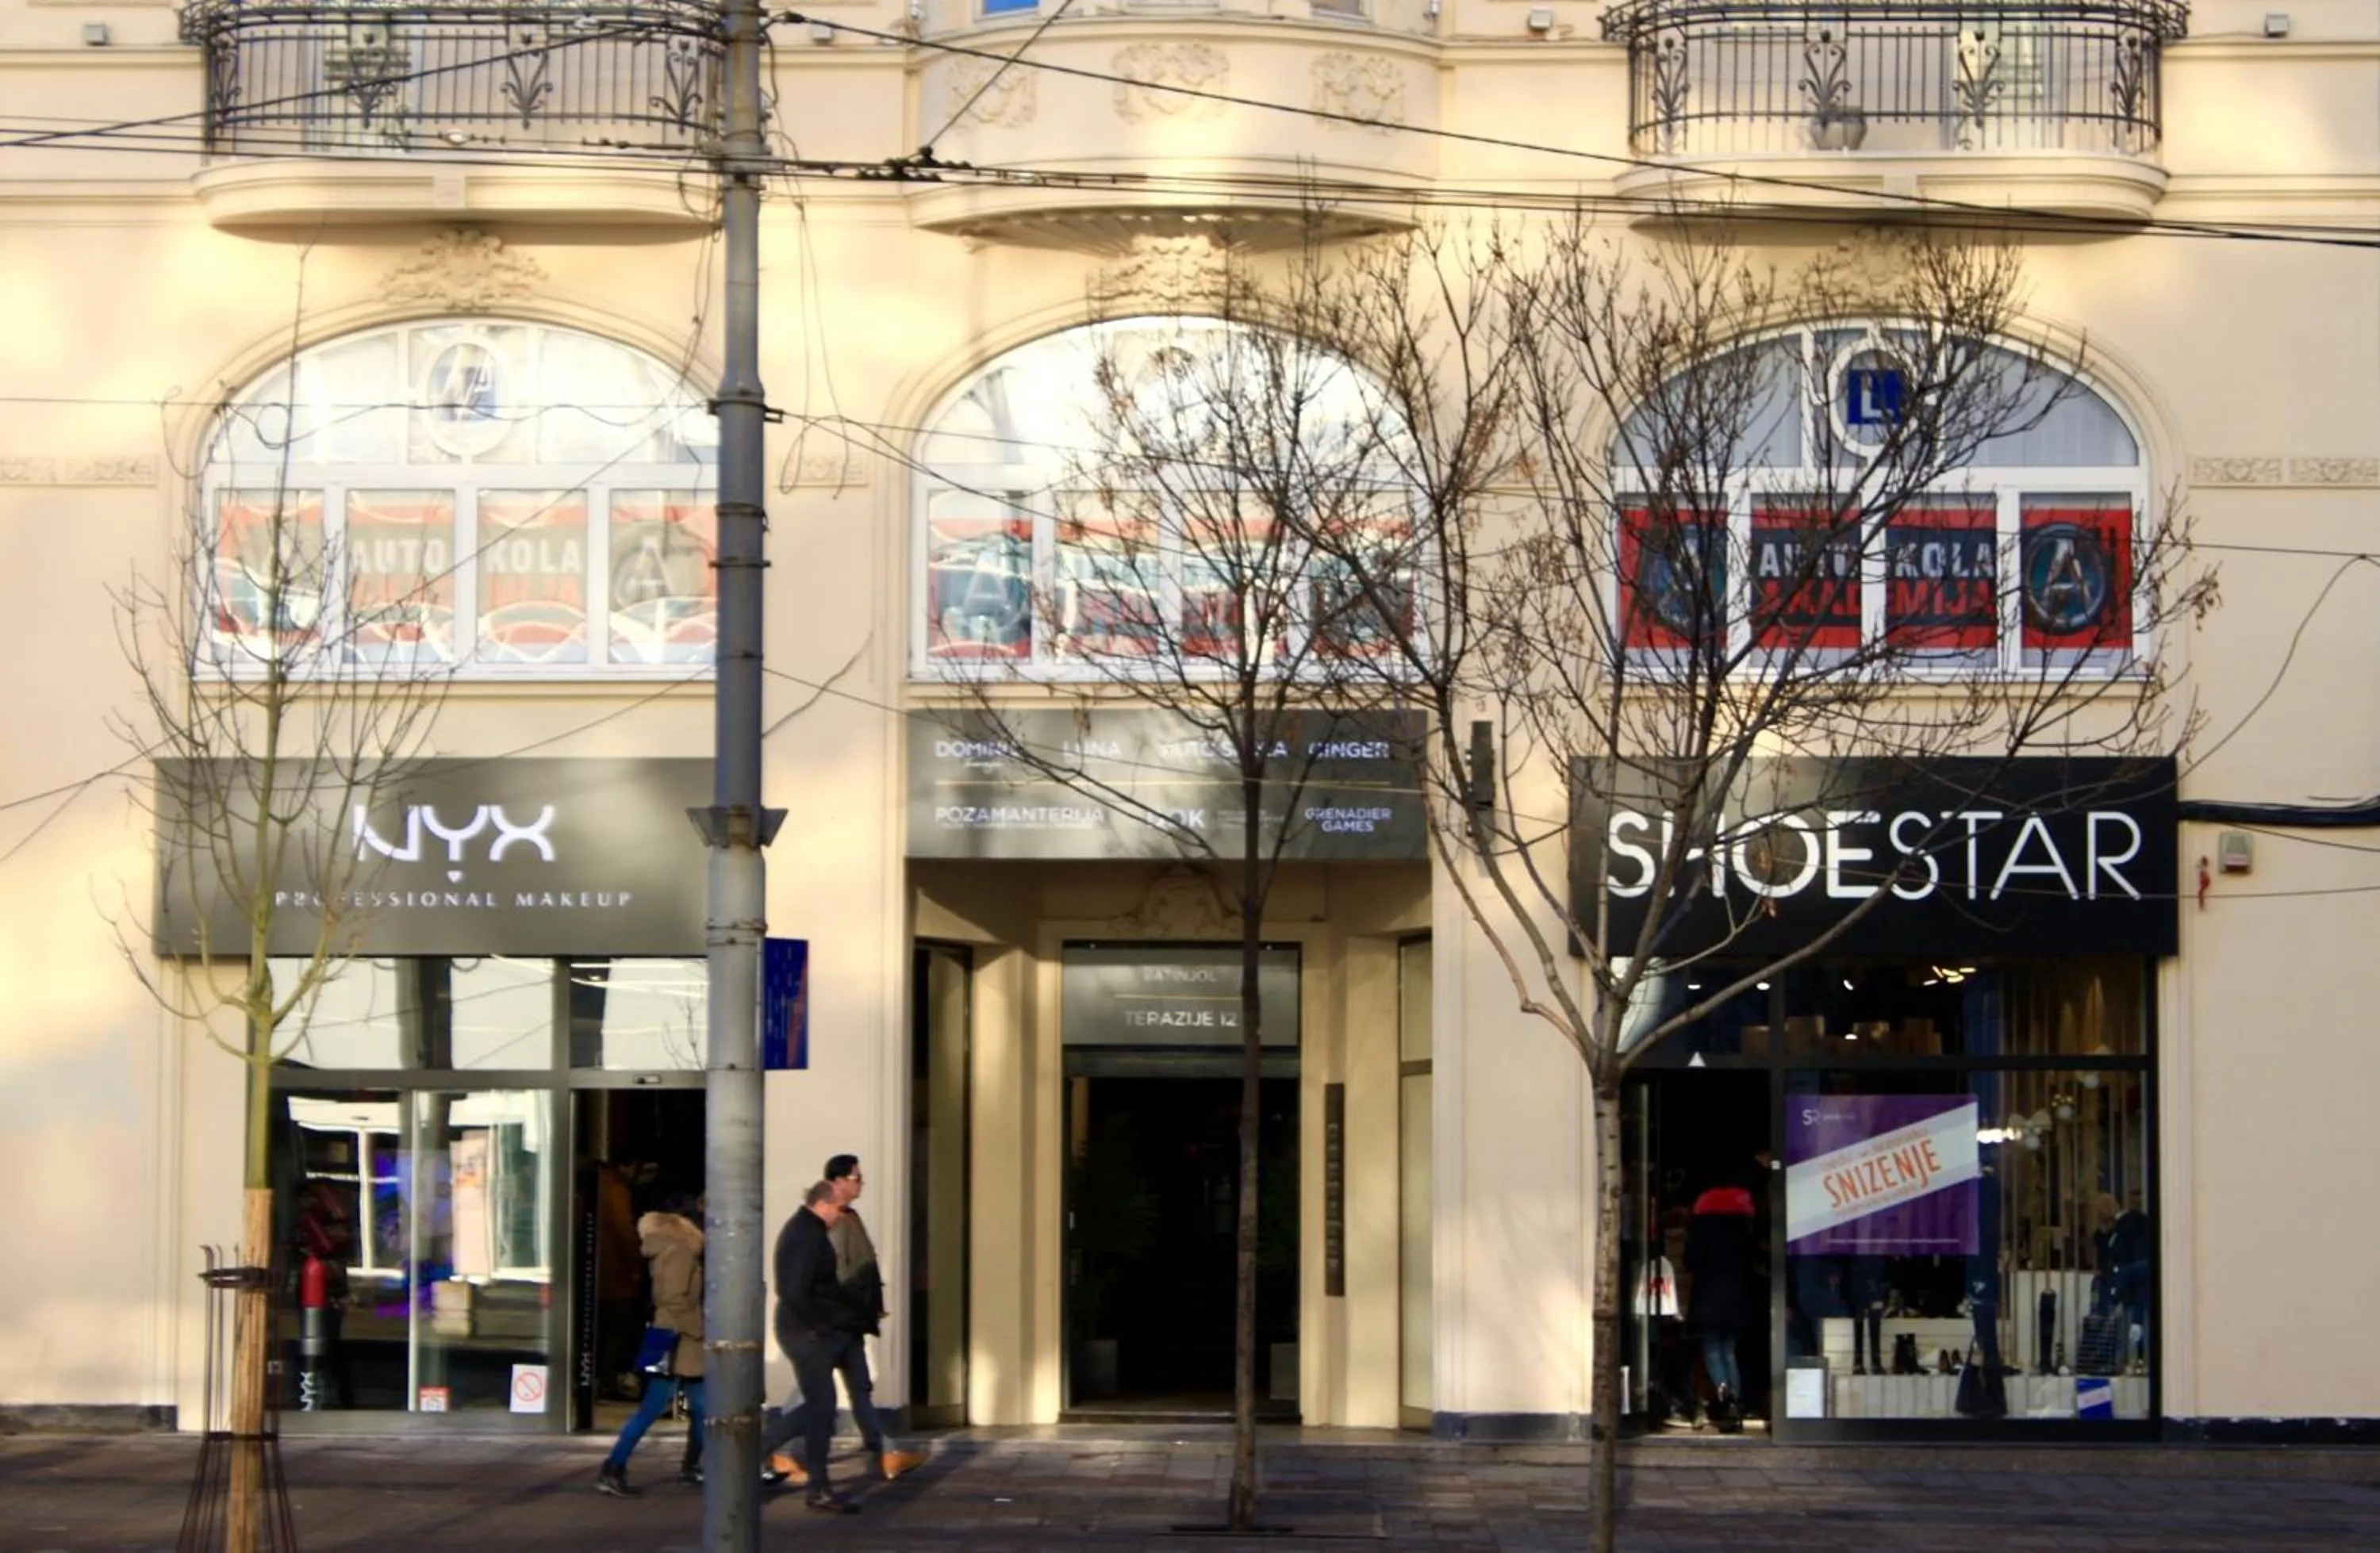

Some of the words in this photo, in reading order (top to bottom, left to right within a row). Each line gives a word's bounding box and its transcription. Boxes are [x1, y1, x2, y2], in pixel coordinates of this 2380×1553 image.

[351, 539, 446, 573] AUTO
[1308, 741, 1390, 759] GINGER
[1304, 807, 1392, 820] GRENADIER
[353, 804, 555, 861] NYX
[1321, 819, 1375, 833] GAMES
[1606, 811, 2142, 900] SHOESTAR
[274, 892, 497, 907] PRESSIONAL
[515, 892, 631, 907] MAKEUP
[1124, 1010, 1214, 1027] TERAZIJE
